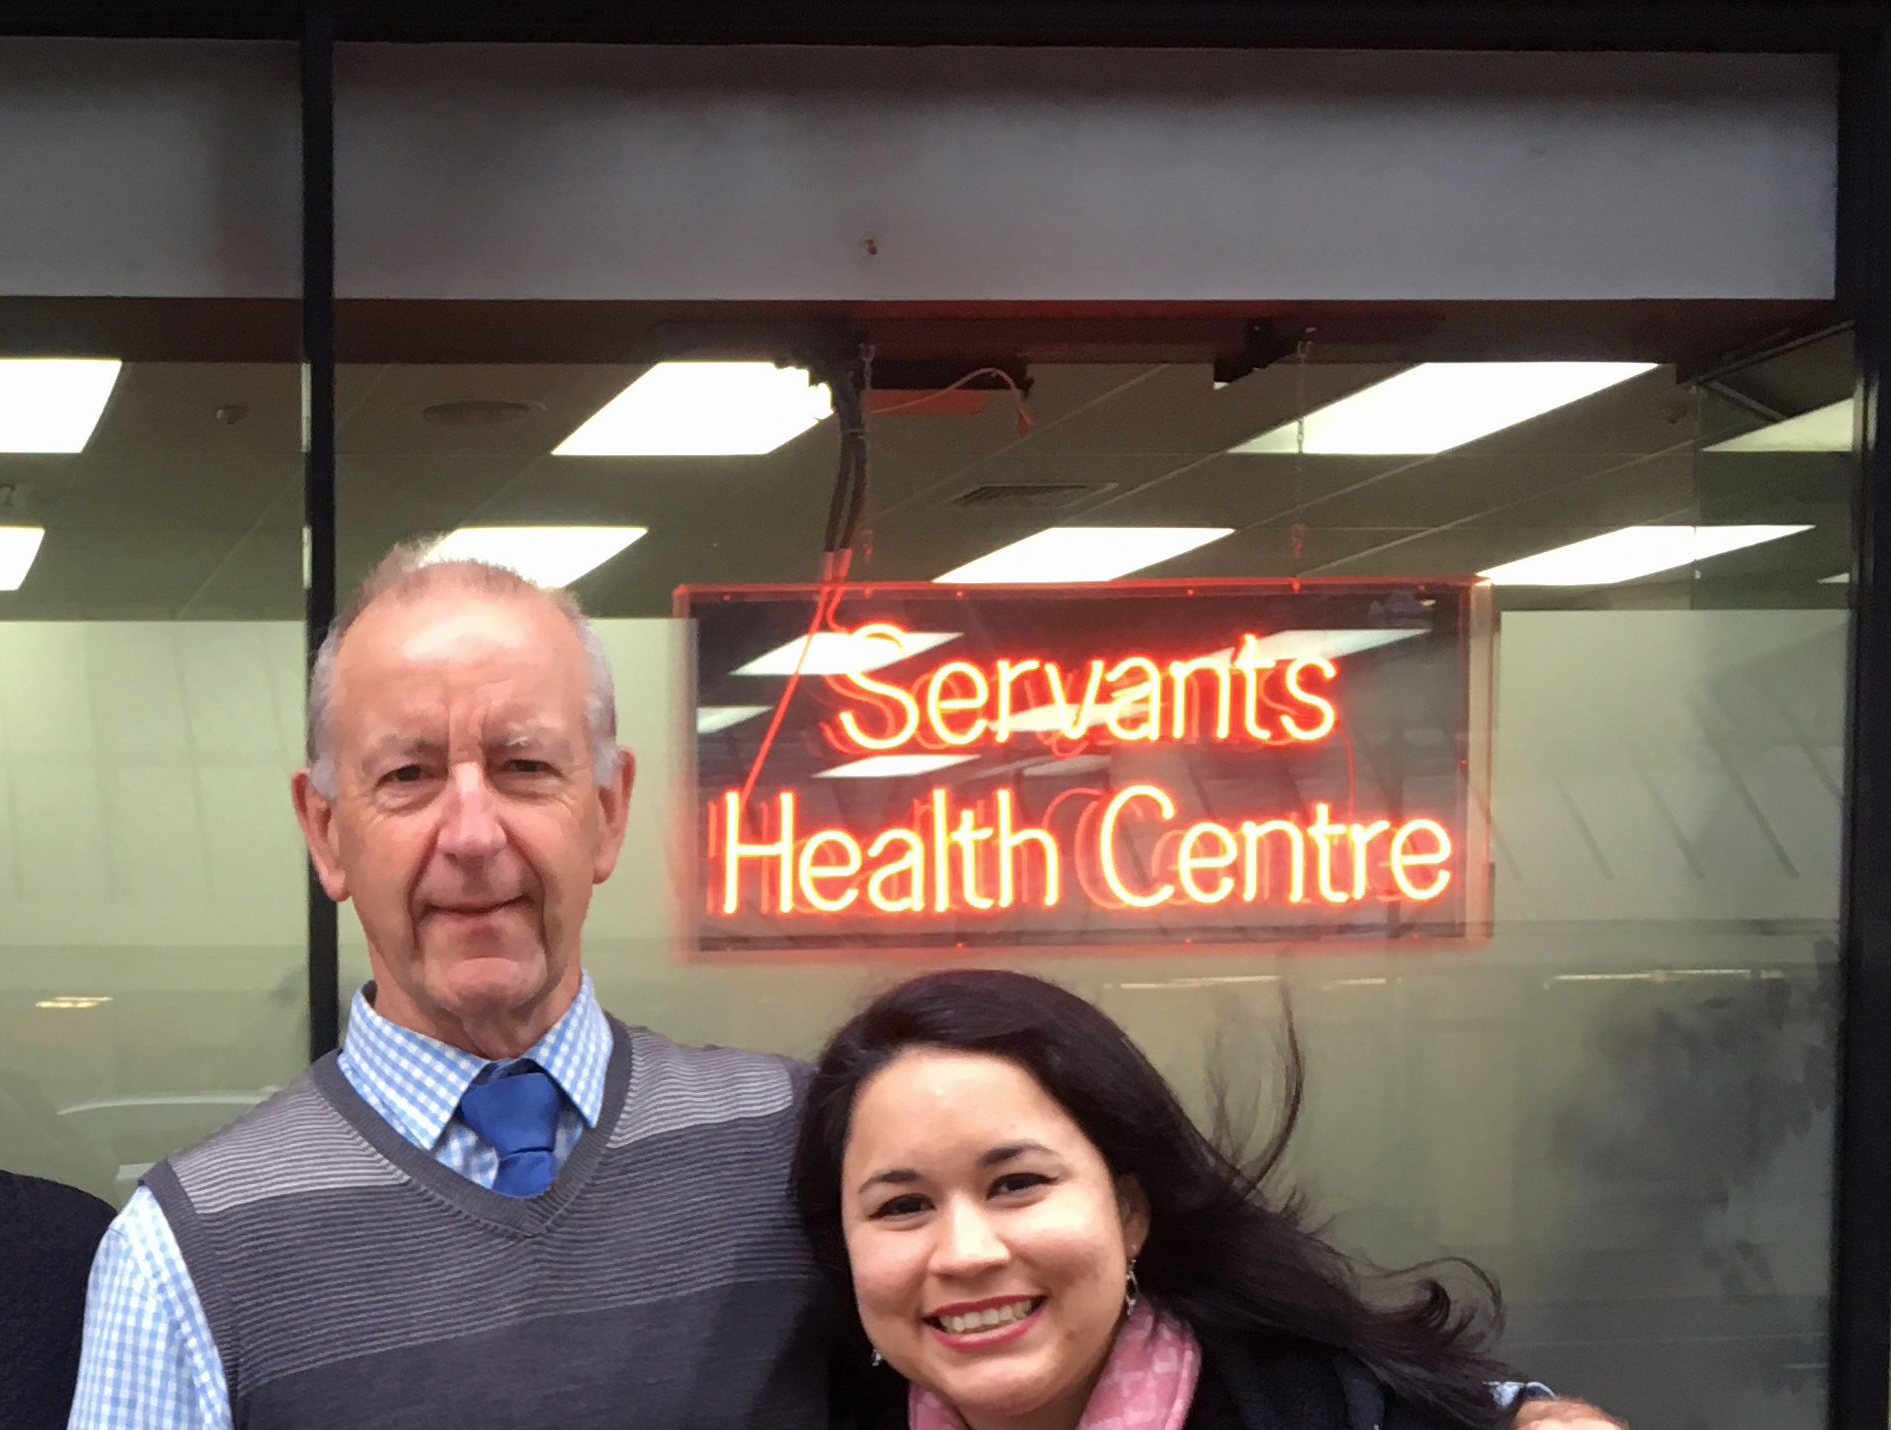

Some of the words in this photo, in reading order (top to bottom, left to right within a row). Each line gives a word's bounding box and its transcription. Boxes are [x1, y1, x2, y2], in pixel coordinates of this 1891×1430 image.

[838, 622, 1338, 750] Servants
[723, 787, 1059, 914] Health
[1099, 784, 1452, 908] Centre
